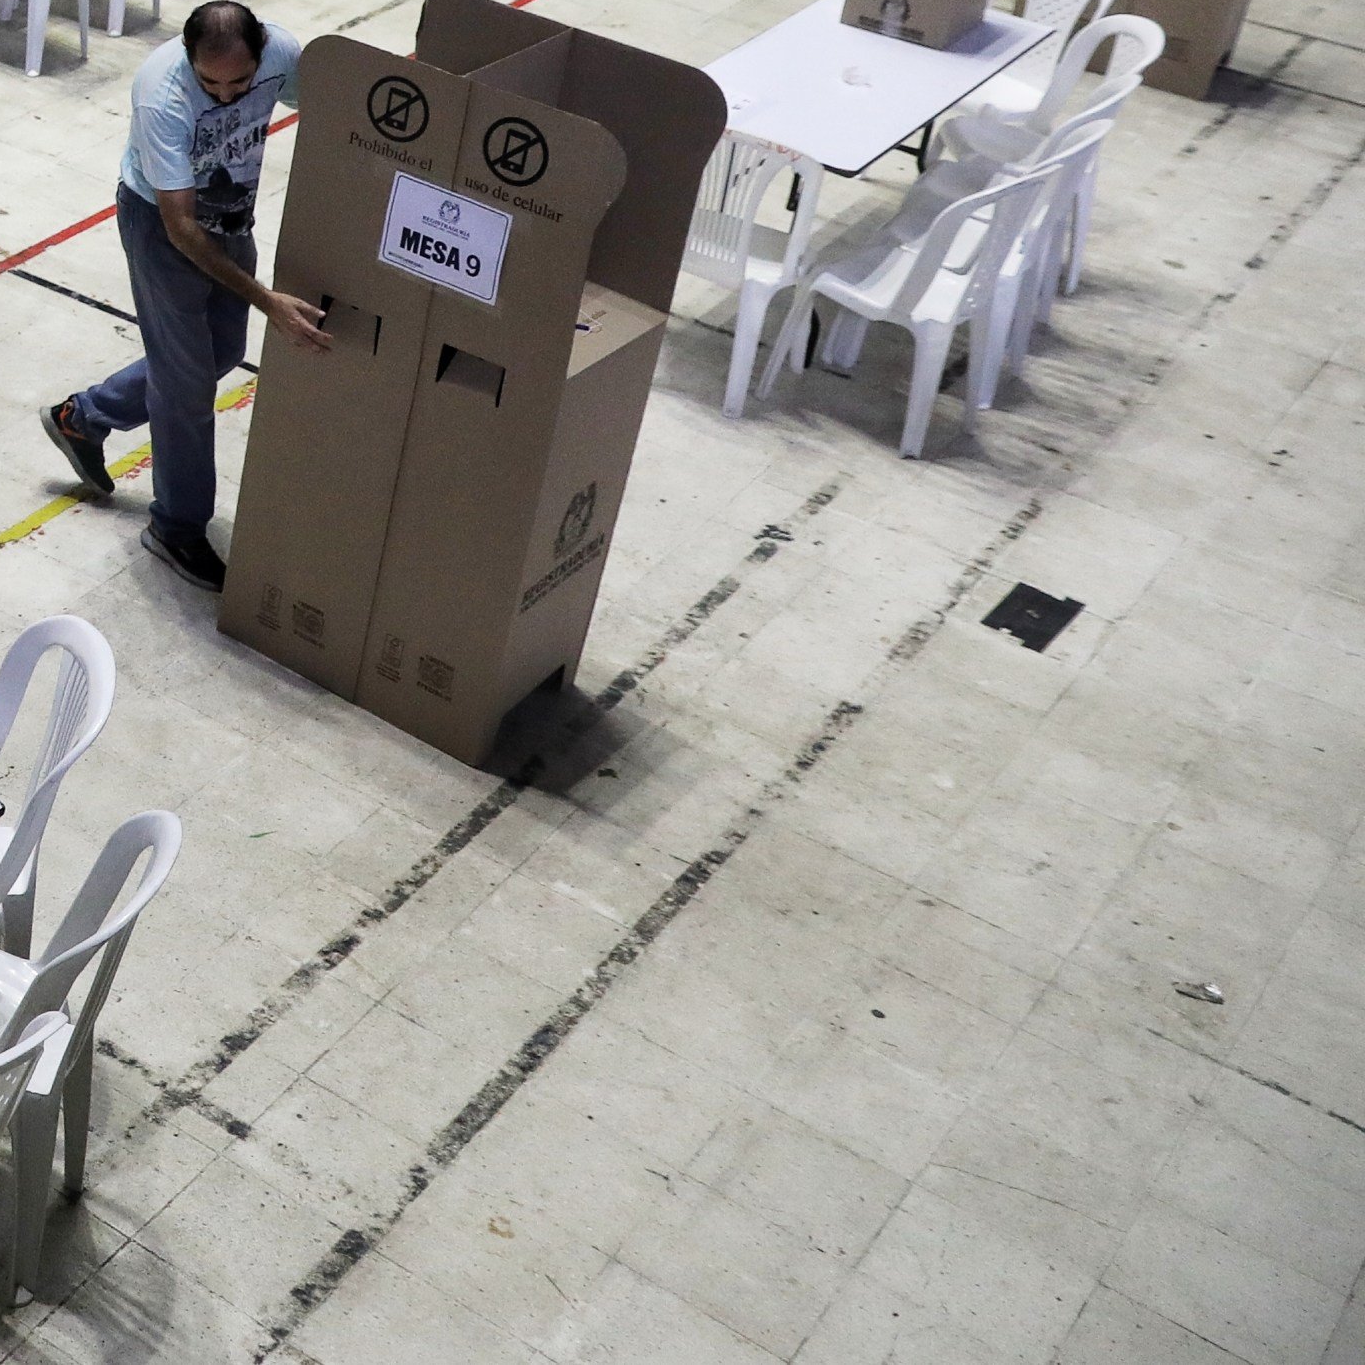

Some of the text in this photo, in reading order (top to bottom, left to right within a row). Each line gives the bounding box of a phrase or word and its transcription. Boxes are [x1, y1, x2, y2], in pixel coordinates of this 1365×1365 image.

[349, 130, 433, 172] Prohibido el
[464, 177, 564, 223] uso de celular
[399, 226, 460, 271] MESA
[465, 254, 482, 278] 9
